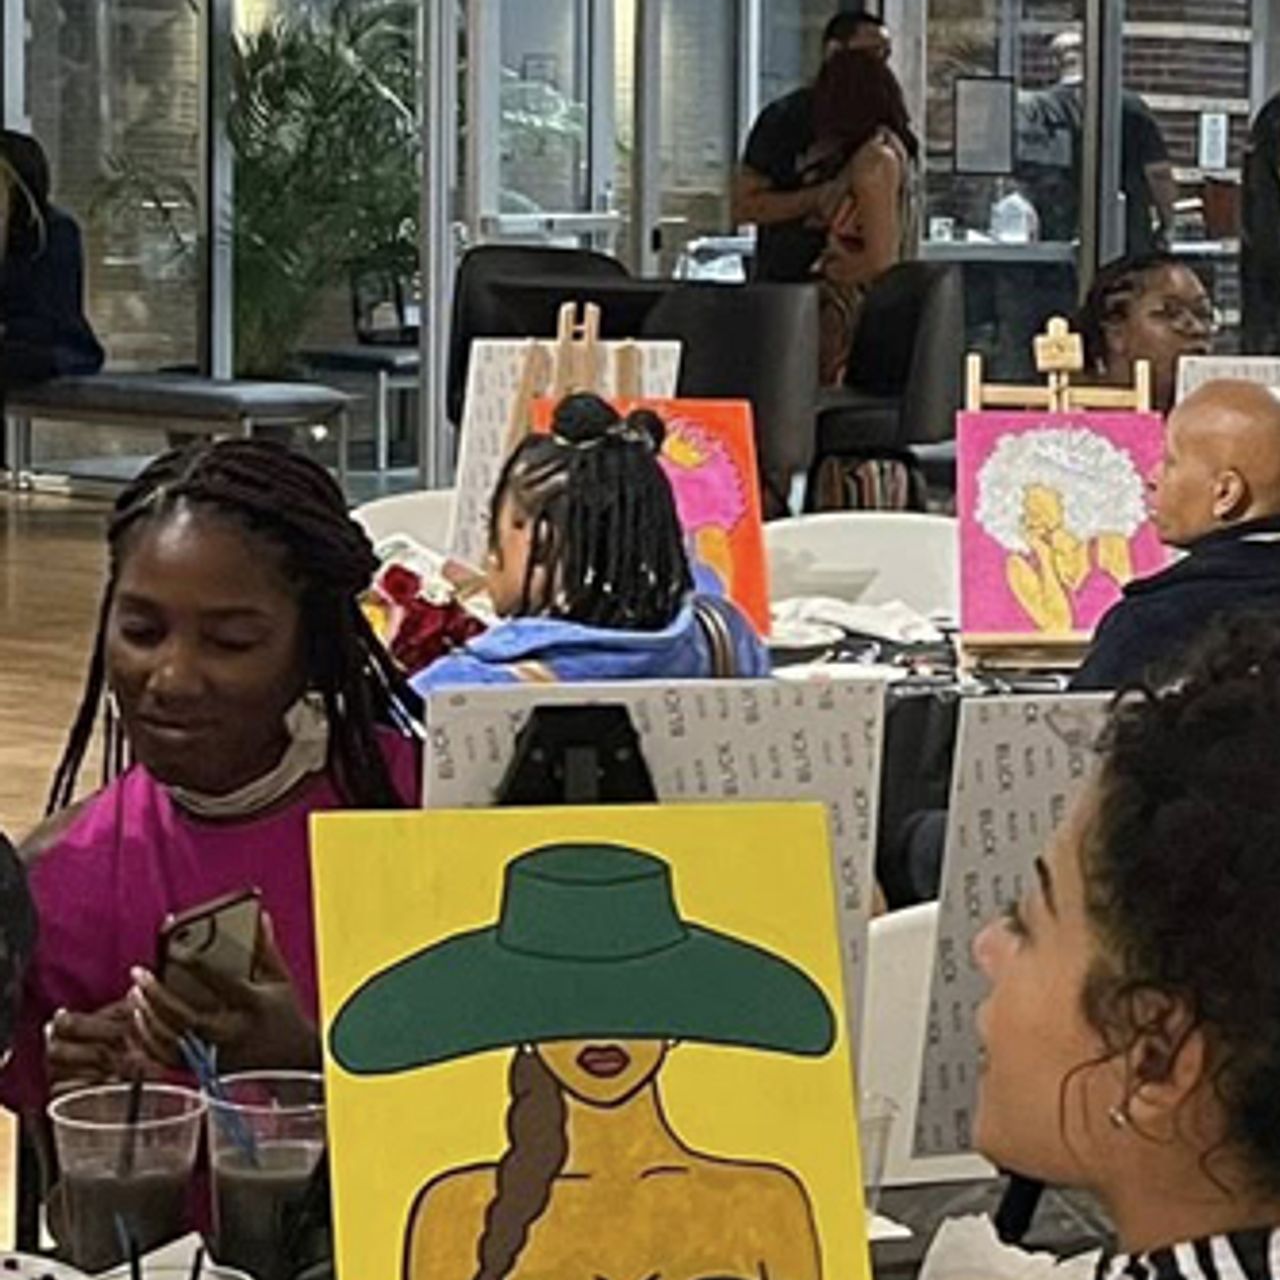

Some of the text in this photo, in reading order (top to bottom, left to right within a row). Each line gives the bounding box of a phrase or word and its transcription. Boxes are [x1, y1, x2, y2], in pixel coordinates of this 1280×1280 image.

[434, 727, 455, 780] BLICK
[718, 740, 738, 795] BLICK
[792, 728, 812, 783] BLICK
[995, 742, 1014, 792] BLICK
[979, 808, 996, 856] BLICK
[842, 855, 860, 910] BLICK
[964, 871, 981, 918] BLICK
[940, 936, 958, 984] BLICK
